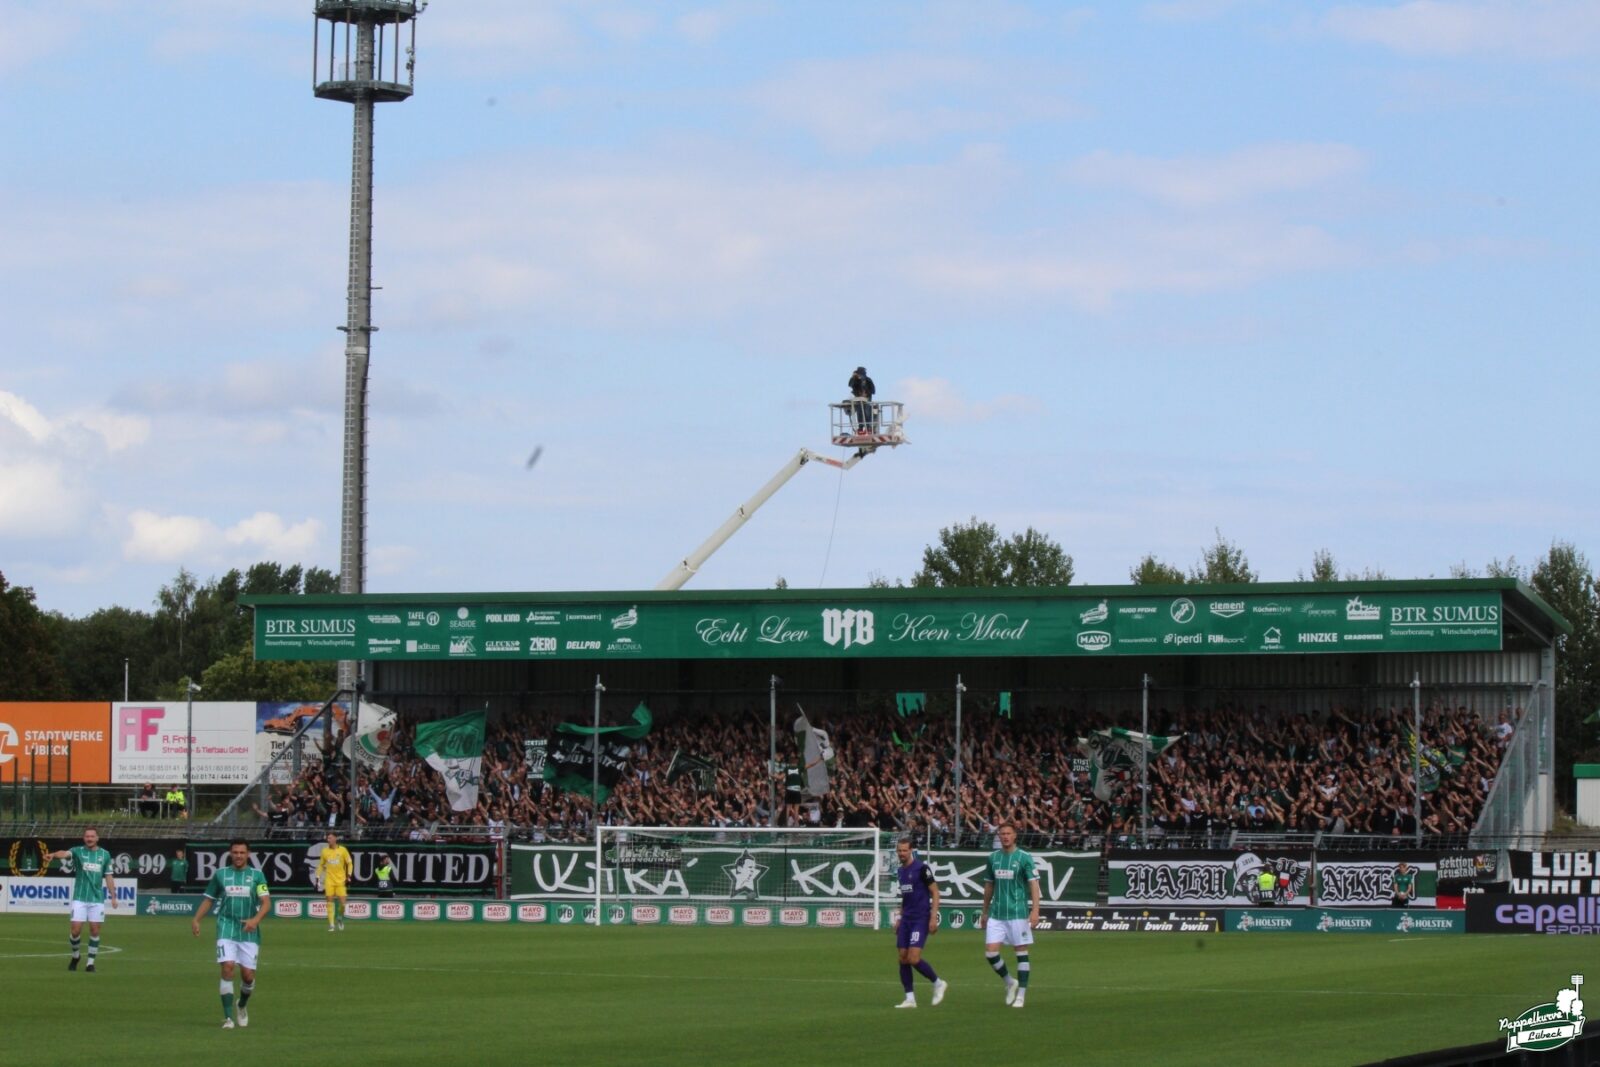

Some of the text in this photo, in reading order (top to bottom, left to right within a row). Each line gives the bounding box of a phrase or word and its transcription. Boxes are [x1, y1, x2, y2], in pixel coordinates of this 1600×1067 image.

[408, 612, 425, 620] TAFEL
[1390, 607, 1428, 622] BTR
[1433, 606, 1498, 622] SUMUS
[266, 619, 356, 633] BTR SUMUS
[888, 612, 1029, 642] Keen Mood
[695, 618, 748, 646] Echt
[1080, 636, 1108, 644] MAYO
[1174, 633, 1202, 646] iperdi
[1298, 633, 1338, 642] HINZKE
[566, 641, 601, 650] DELLPRO
[24, 730, 104, 741] STADTWERKE
[138, 853, 166, 875] 99
[10, 885, 70, 899] WOISIN
[161, 903, 192, 912] HOLSTEN
[1066, 921, 1094, 930] bwin
[1102, 921, 1130, 930] bwin
[1144, 922, 1173, 930] bwin
[1180, 922, 1209, 931] bwin
[1334, 919, 1372, 927] HOLSTEN
[1415, 920, 1453, 928] HOLSTEN
